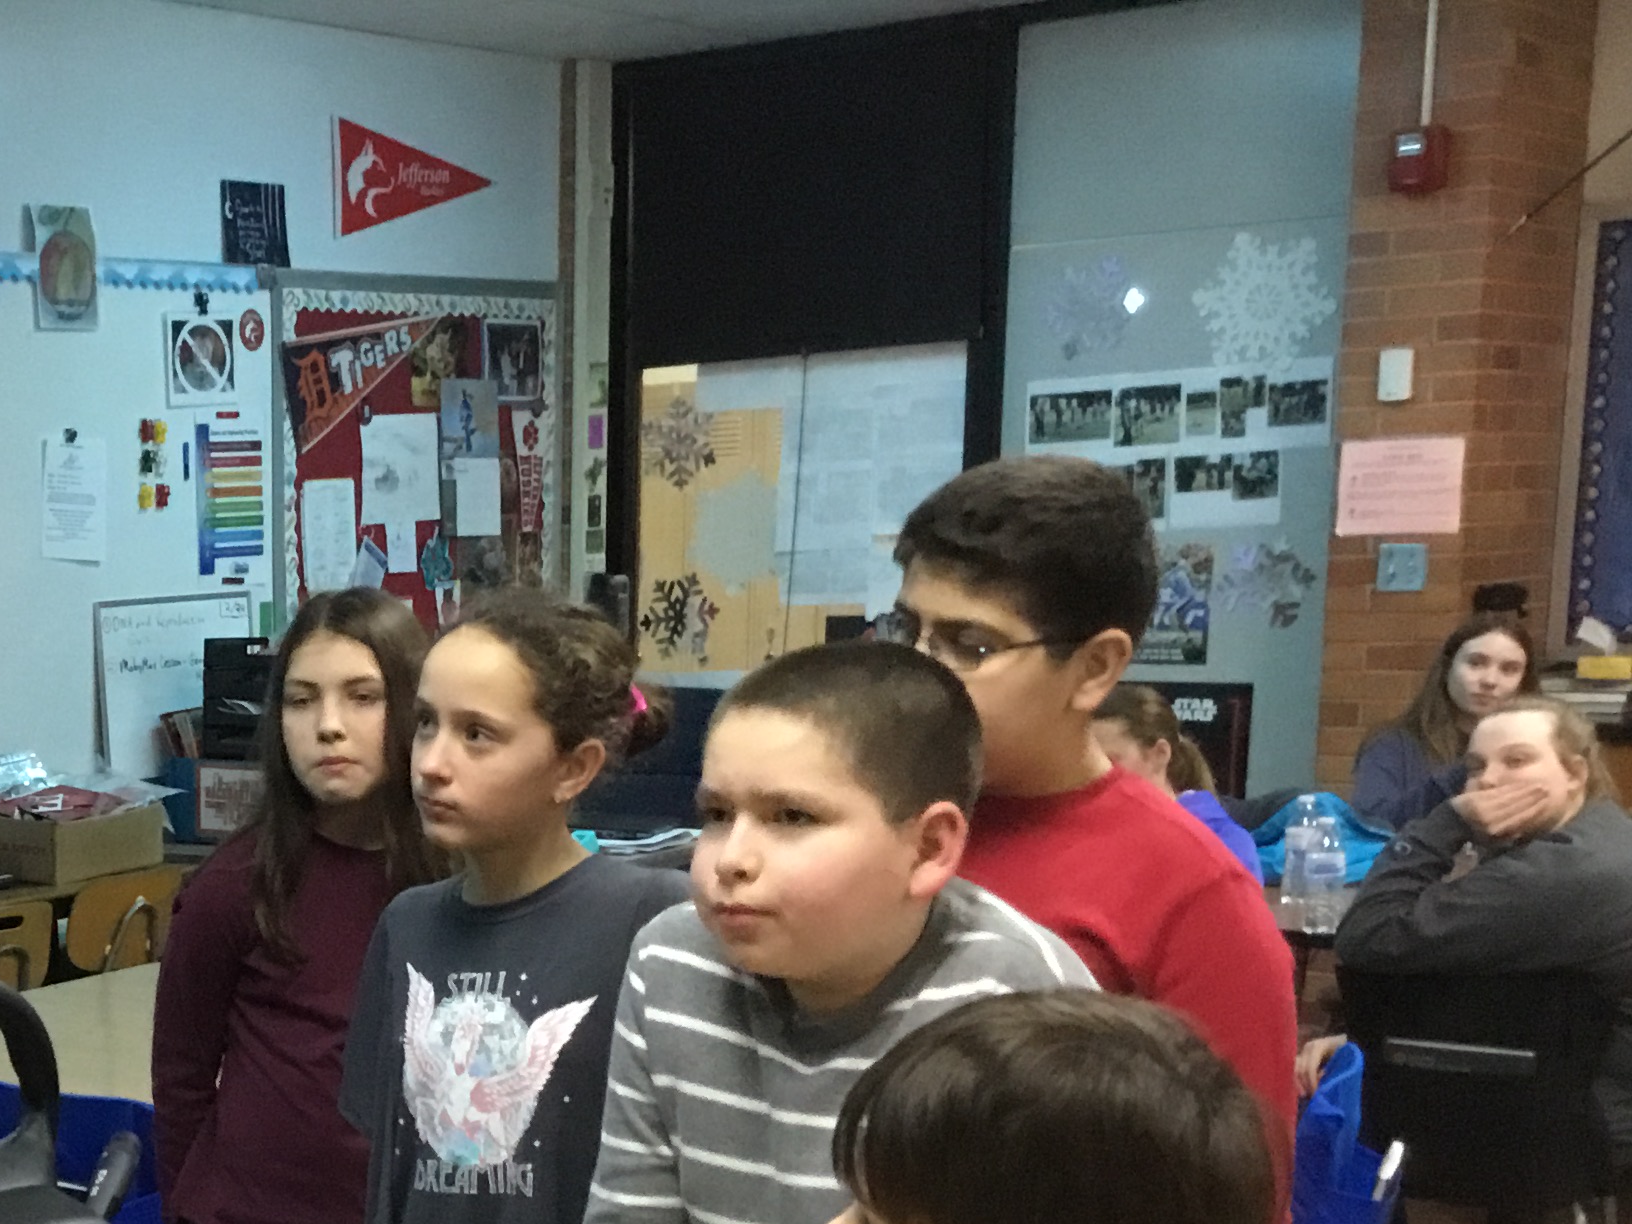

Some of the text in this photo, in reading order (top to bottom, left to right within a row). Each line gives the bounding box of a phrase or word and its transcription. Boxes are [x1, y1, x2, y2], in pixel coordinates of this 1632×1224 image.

[397, 162, 450, 188] Jefferson
[1171, 697, 1217, 711] STAR
[1172, 708, 1217, 722] WARS
[447, 970, 507, 1003] STILL
[413, 1157, 533, 1198] DREAMING
